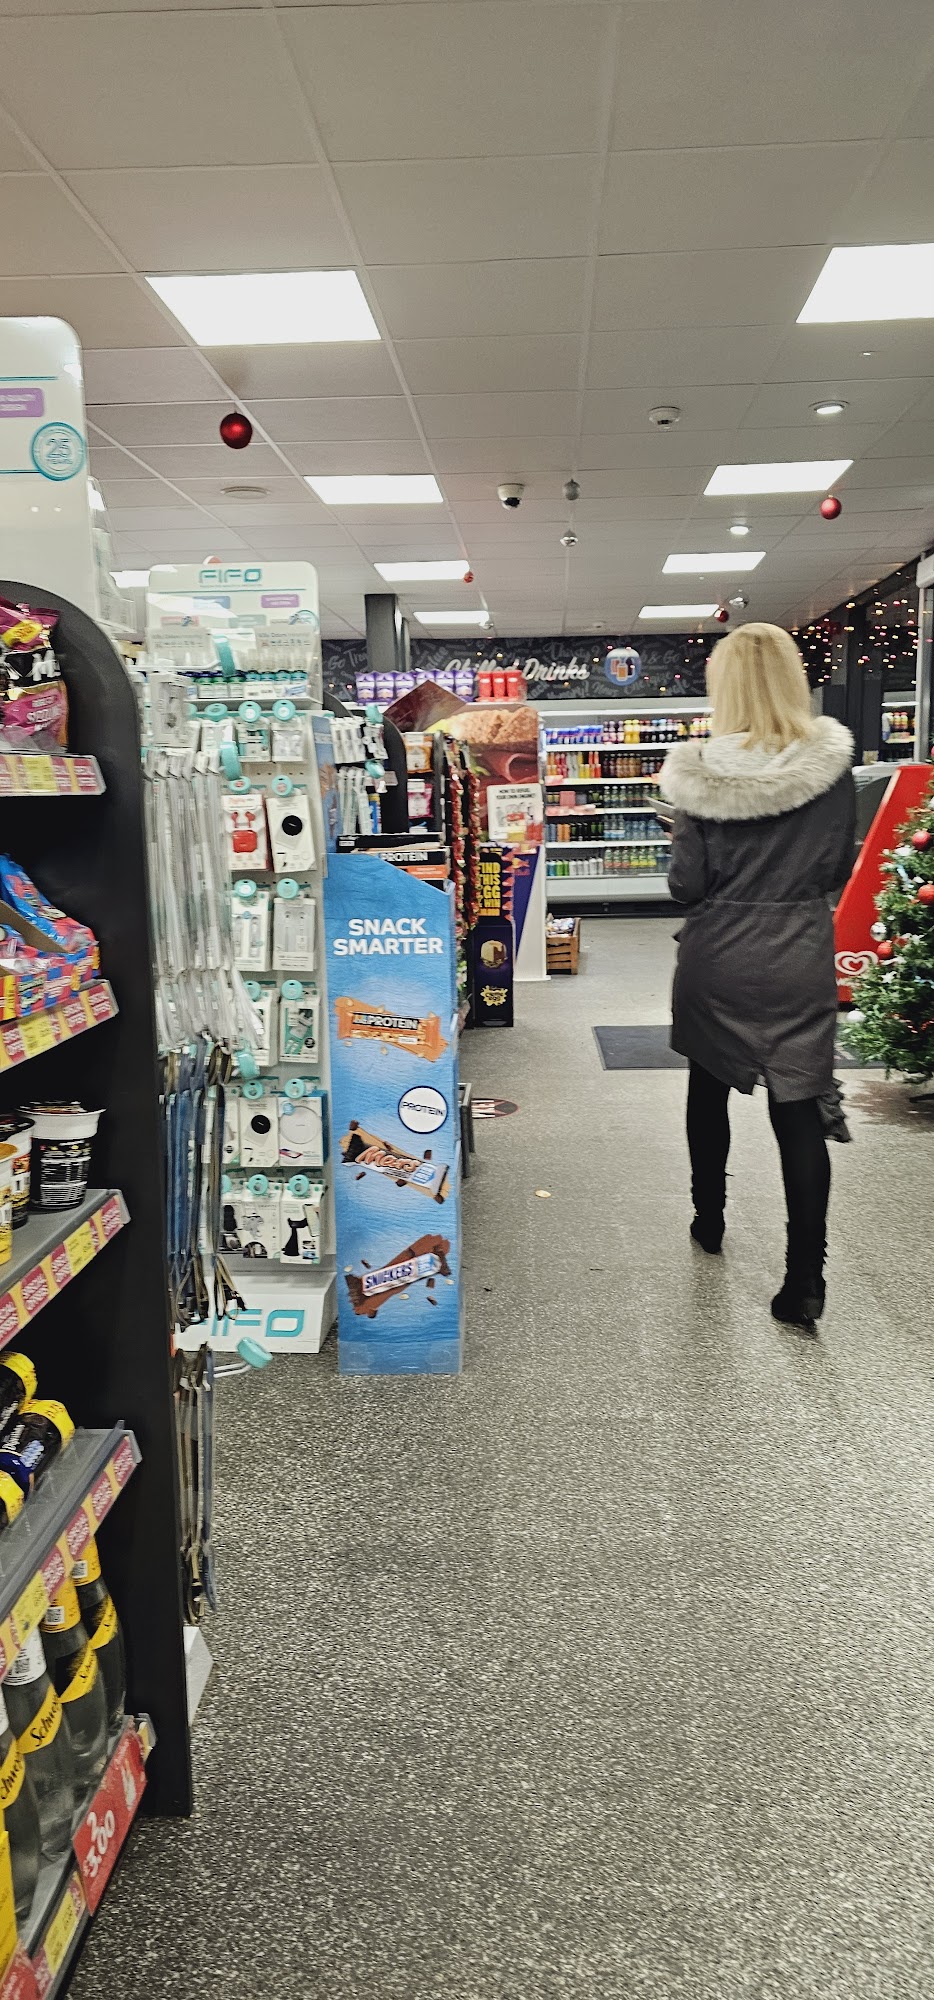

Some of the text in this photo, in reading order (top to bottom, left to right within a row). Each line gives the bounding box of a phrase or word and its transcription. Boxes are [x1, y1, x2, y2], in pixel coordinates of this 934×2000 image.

[199, 569, 263, 583] FIFO
[522, 656, 590, 681] Drinks
[348, 918, 427, 936] SNACK
[333, 937, 444, 955] SMARTER
[367, 1015, 418, 1029] PROTEIN
[401, 1101, 446, 1116] PROTEIN
[355, 1146, 422, 1173] Mars
[365, 1262, 412, 1289] SNICKERS
